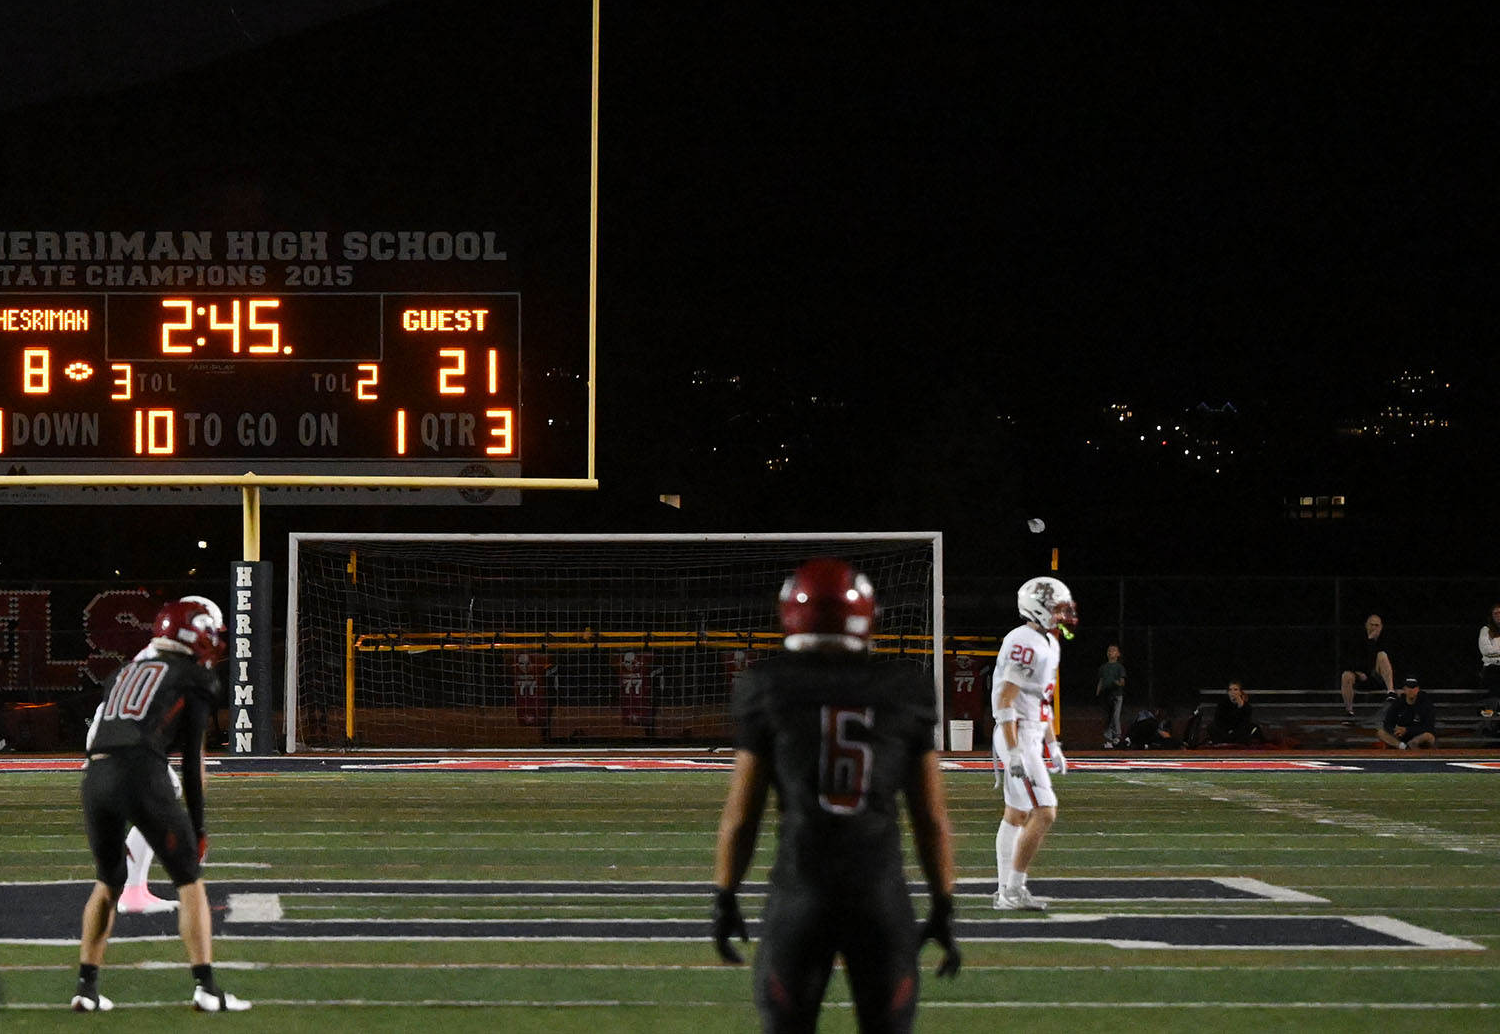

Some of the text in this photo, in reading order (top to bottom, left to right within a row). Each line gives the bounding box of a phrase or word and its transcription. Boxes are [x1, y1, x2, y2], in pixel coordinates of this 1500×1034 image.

[226, 230, 329, 261] HIGH
[343, 230, 508, 261] SCHOOL
[86, 265, 267, 287] CHAMPIONS
[285, 265, 354, 287] 2015
[403, 309, 490, 332] GUEST
[23, 348, 50, 394] 8
[111, 363, 177, 400] 3 TOL
[311, 363, 379, 401] TOL 2
[439, 348, 498, 394] 21
[11, 412, 100, 447] DOWN
[135, 409, 174, 455] 10
[182, 412, 223, 447] TO
[236, 412, 278, 447] GO
[299, 412, 339, 447] ON
[397, 409, 406, 455] 1
[420, 412, 477, 452] QTR
[485, 409, 513, 455] 3
[234, 566, 254, 753] HERRIMAN
[1010, 644, 1035, 665] 20
[103, 661, 170, 722] 10
[623, 678, 643, 695] 77
[954, 676, 976, 693] 77
